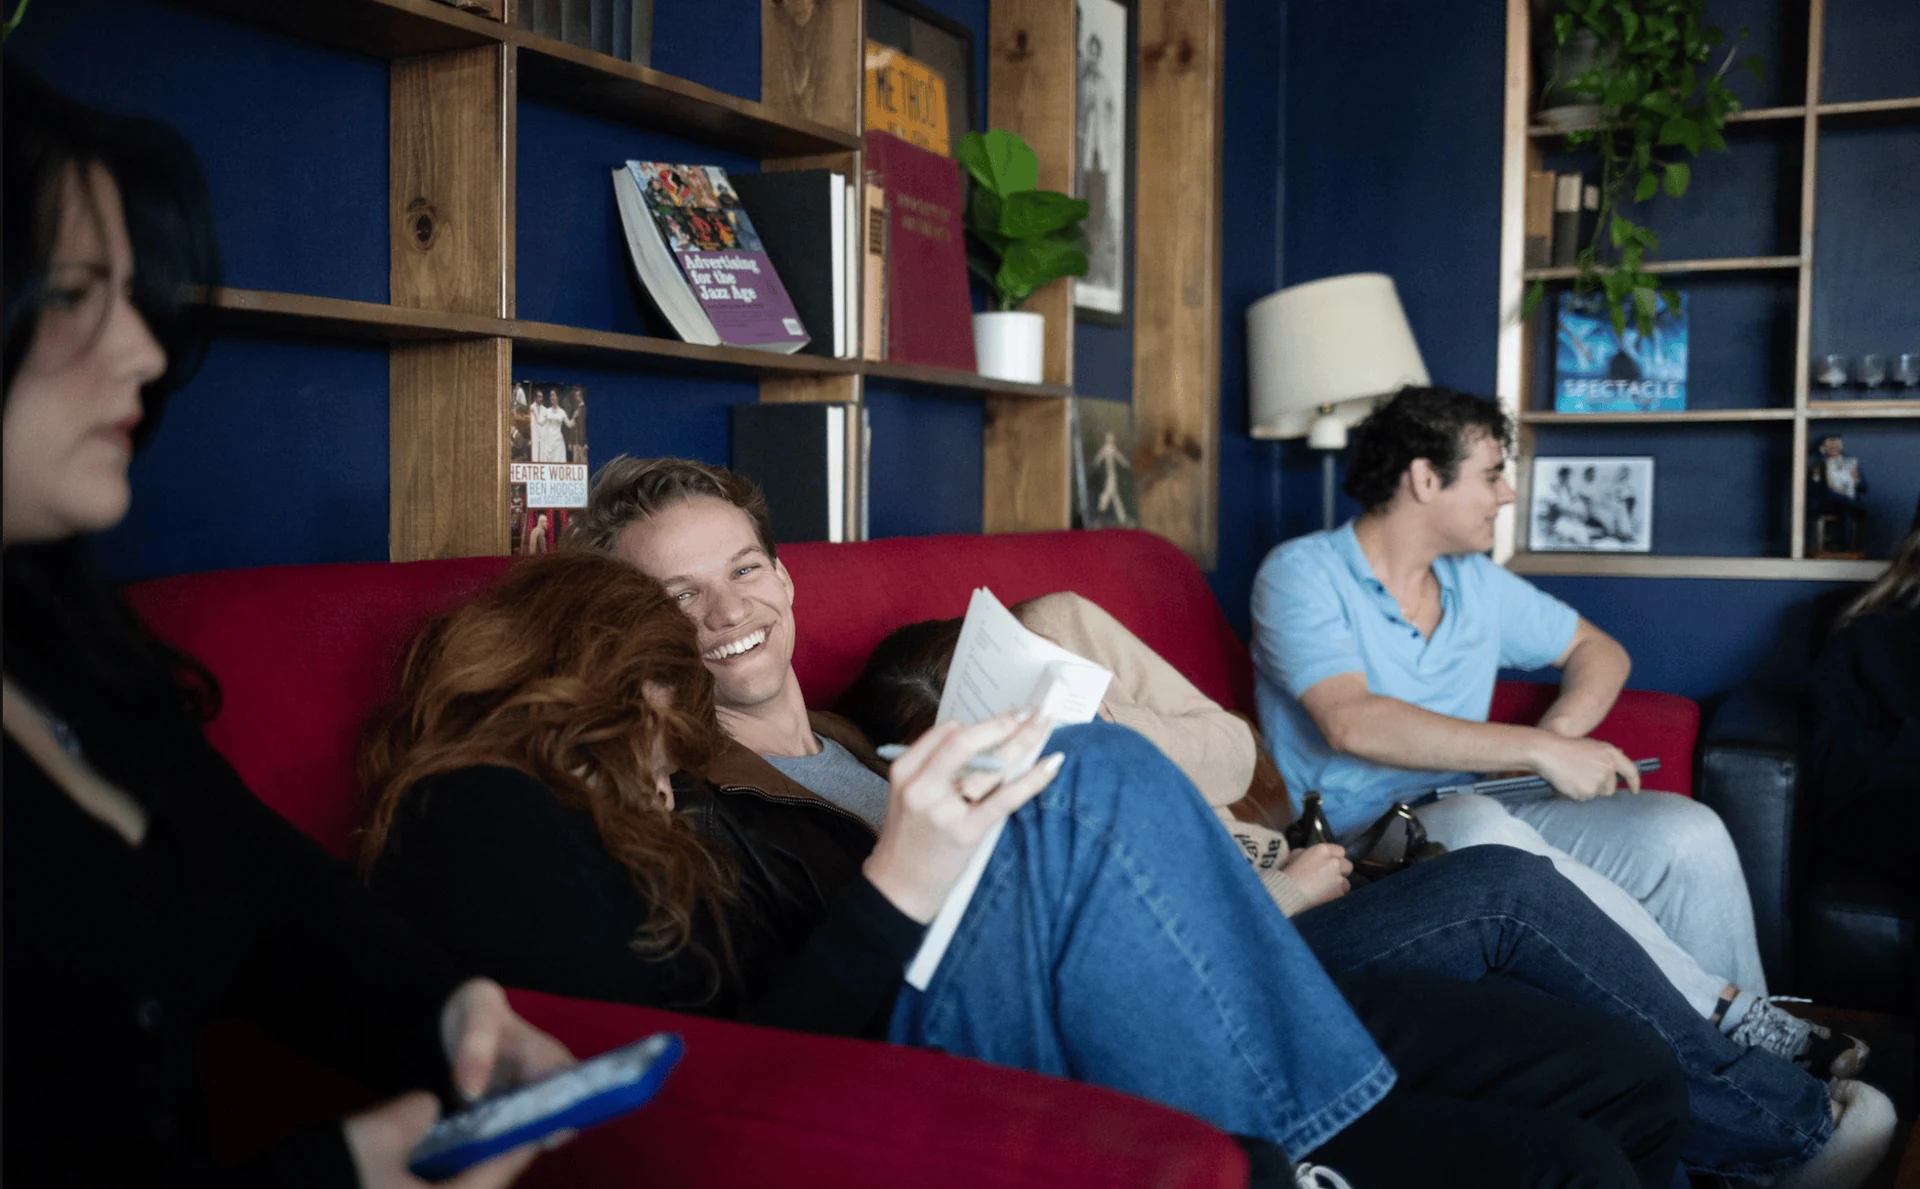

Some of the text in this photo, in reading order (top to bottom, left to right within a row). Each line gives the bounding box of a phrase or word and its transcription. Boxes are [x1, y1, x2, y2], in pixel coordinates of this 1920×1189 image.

[684, 254, 761, 275] Advertising
[690, 269, 737, 285] for the
[699, 284, 758, 304] Jazz Age
[1563, 379, 1681, 399] SPECTACLE
[511, 465, 584, 481] HEATRE WORLD
[529, 482, 585, 496] BEN HODGES
